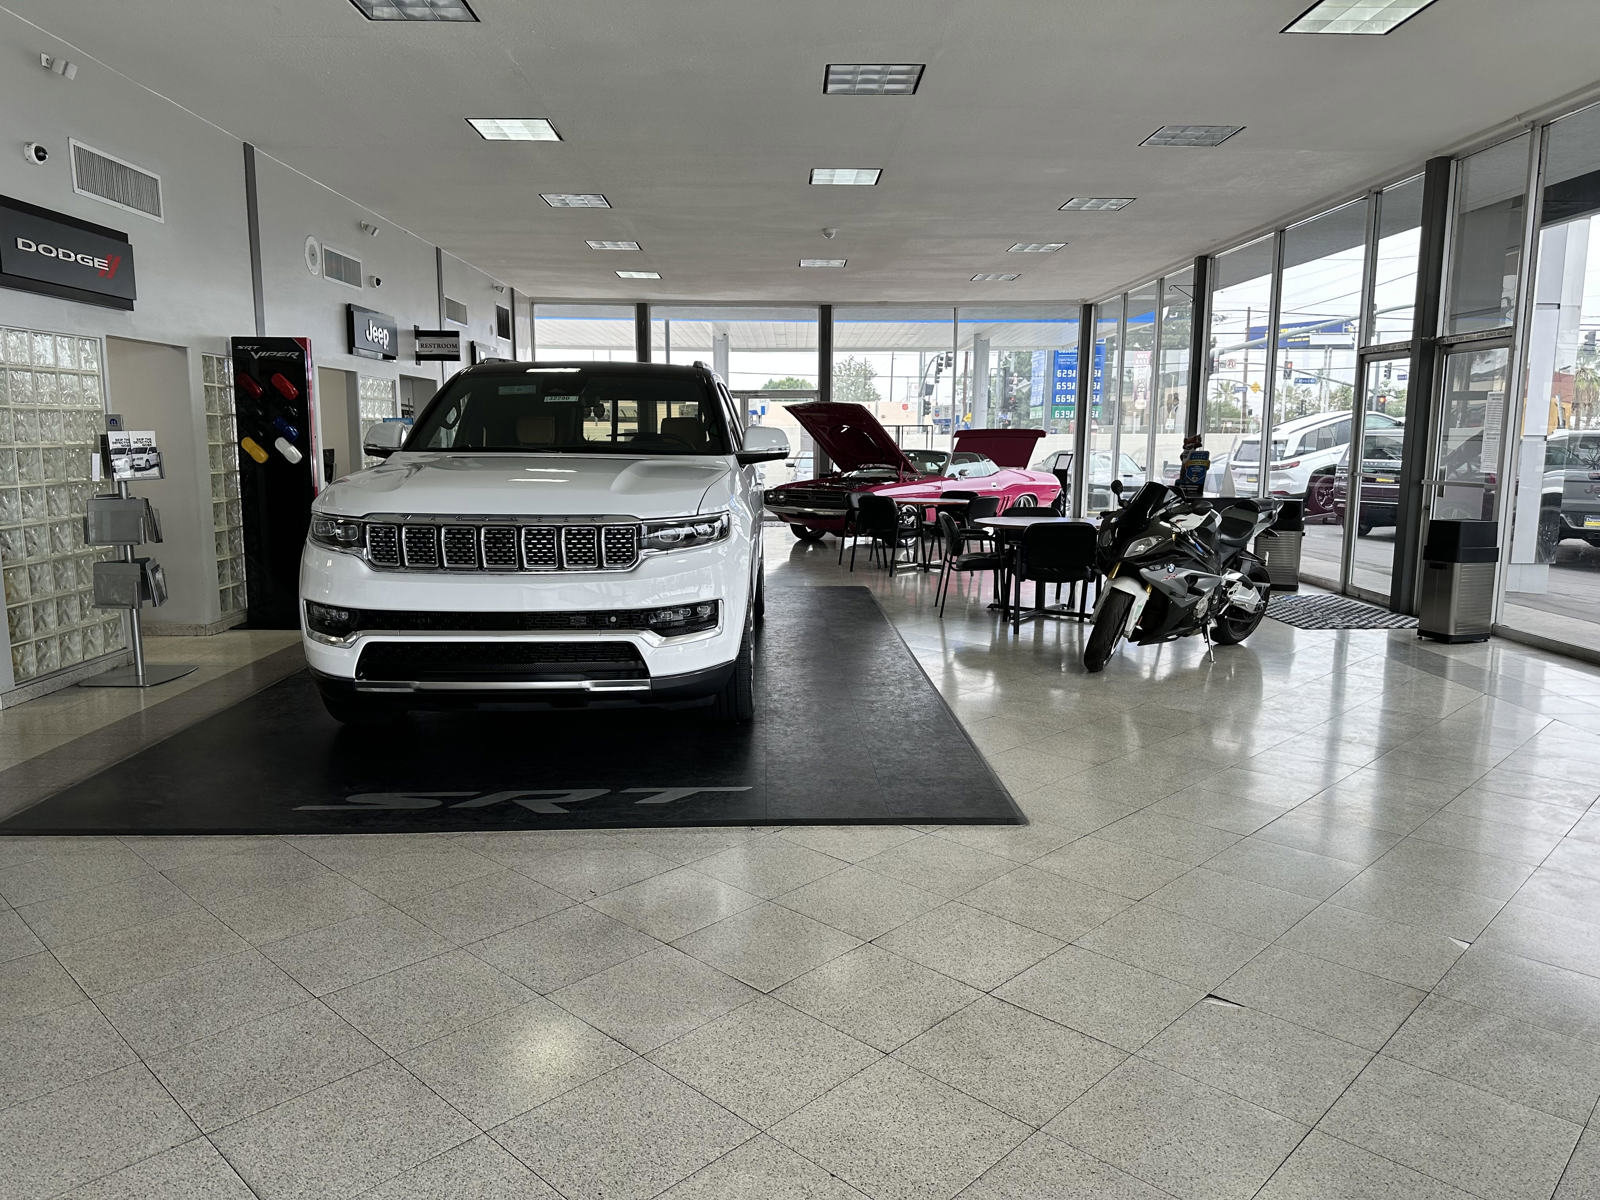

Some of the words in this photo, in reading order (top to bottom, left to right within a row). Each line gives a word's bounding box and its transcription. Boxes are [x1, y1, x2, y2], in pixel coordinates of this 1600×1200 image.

[16, 236, 110, 271] DODGE
[366, 319, 390, 349] Jeep
[250, 351, 300, 359] VIPER
[290, 786, 753, 814] SRT
